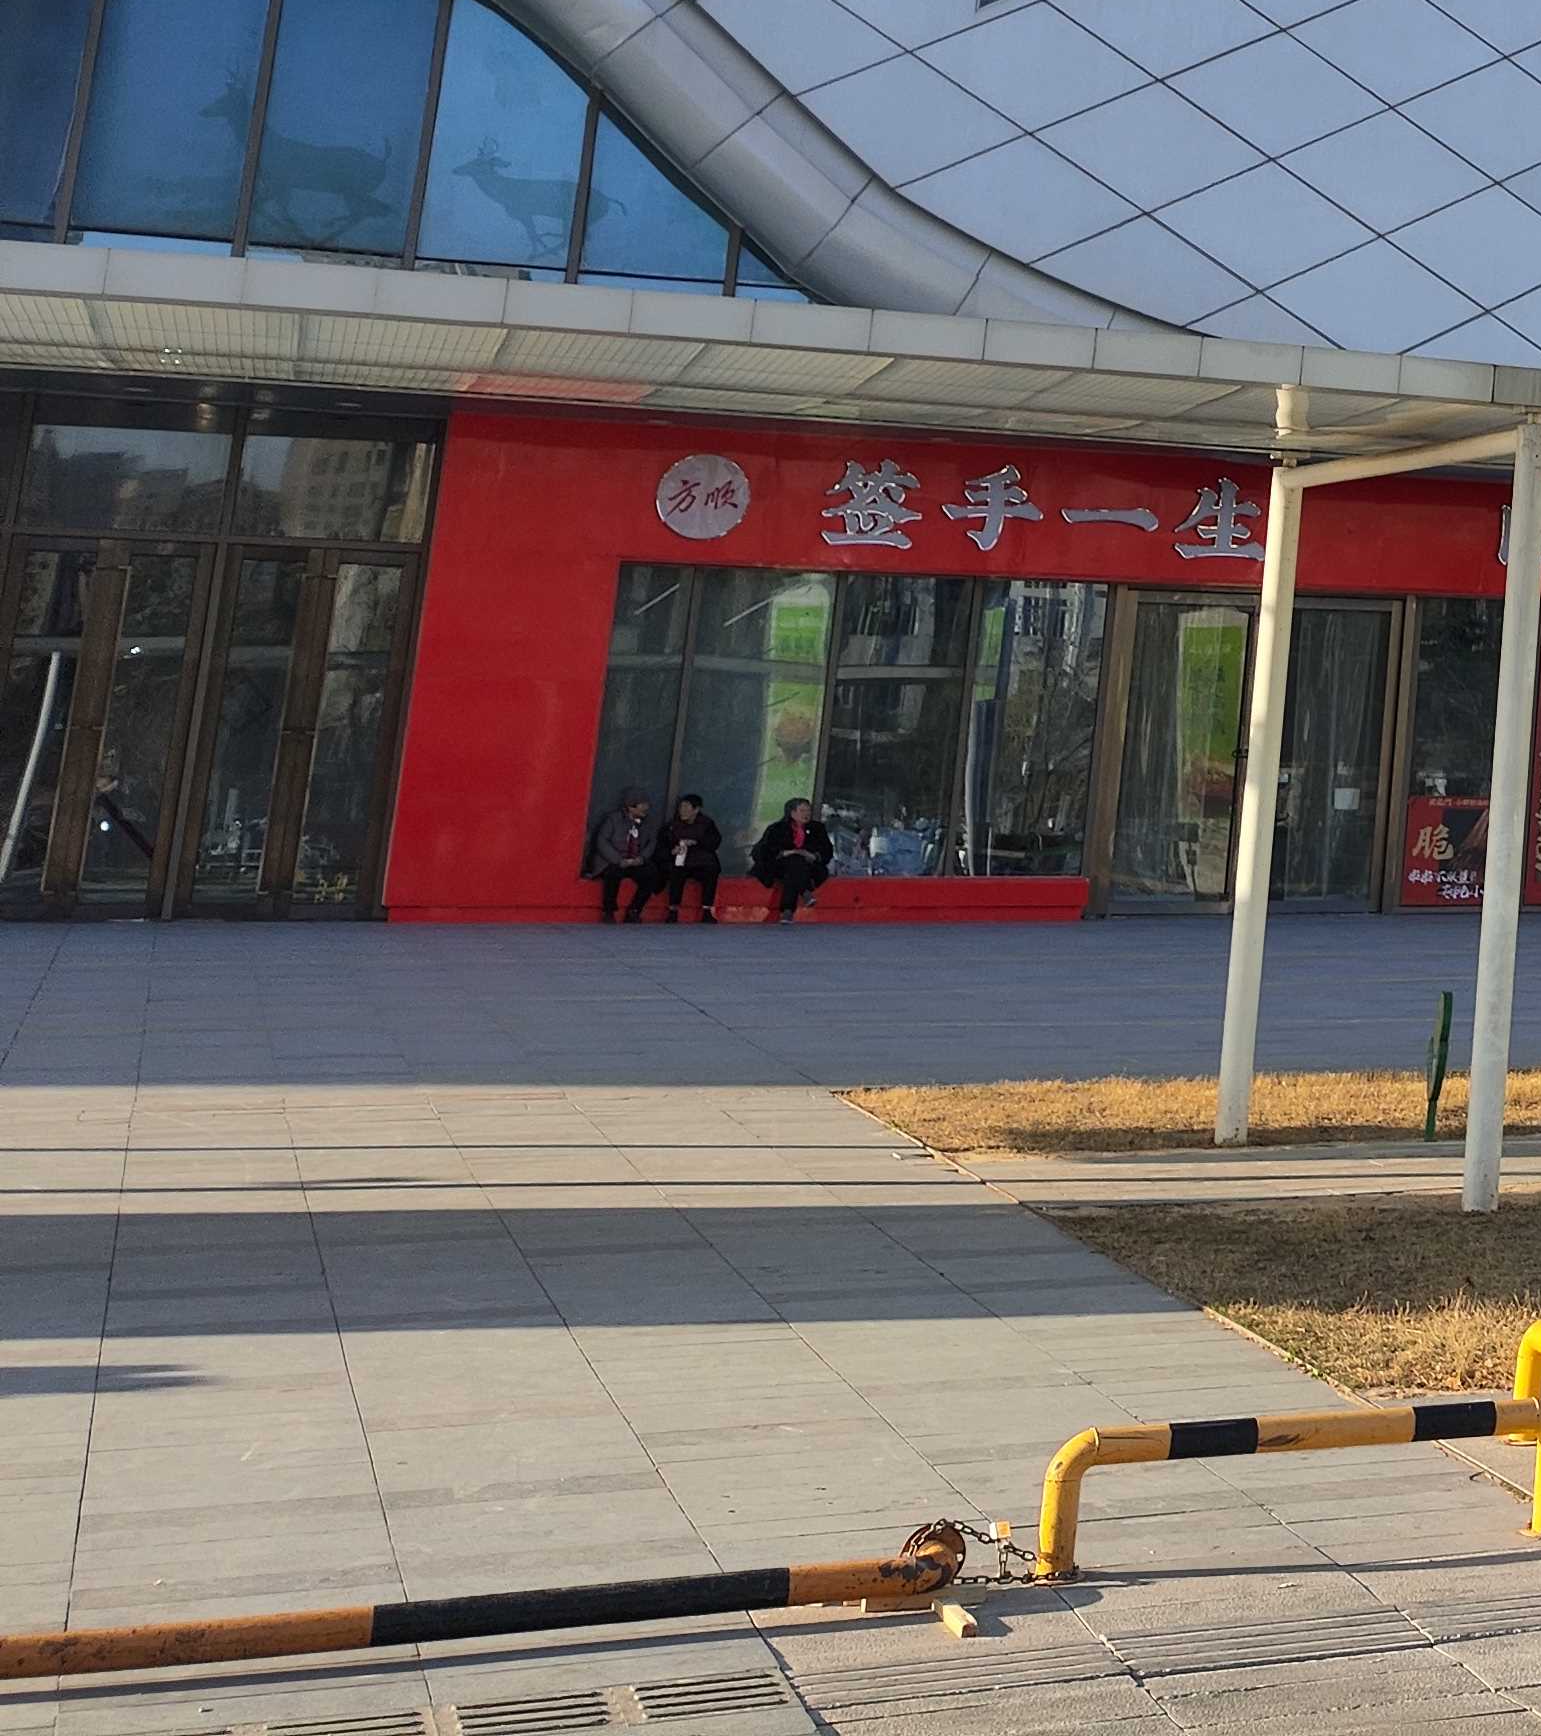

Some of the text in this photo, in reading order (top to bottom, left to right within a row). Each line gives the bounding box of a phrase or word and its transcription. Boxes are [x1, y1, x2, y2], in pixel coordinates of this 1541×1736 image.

[822, 459, 1265, 562] 签手一生
[1411, 823, 1455, 861] 脆
